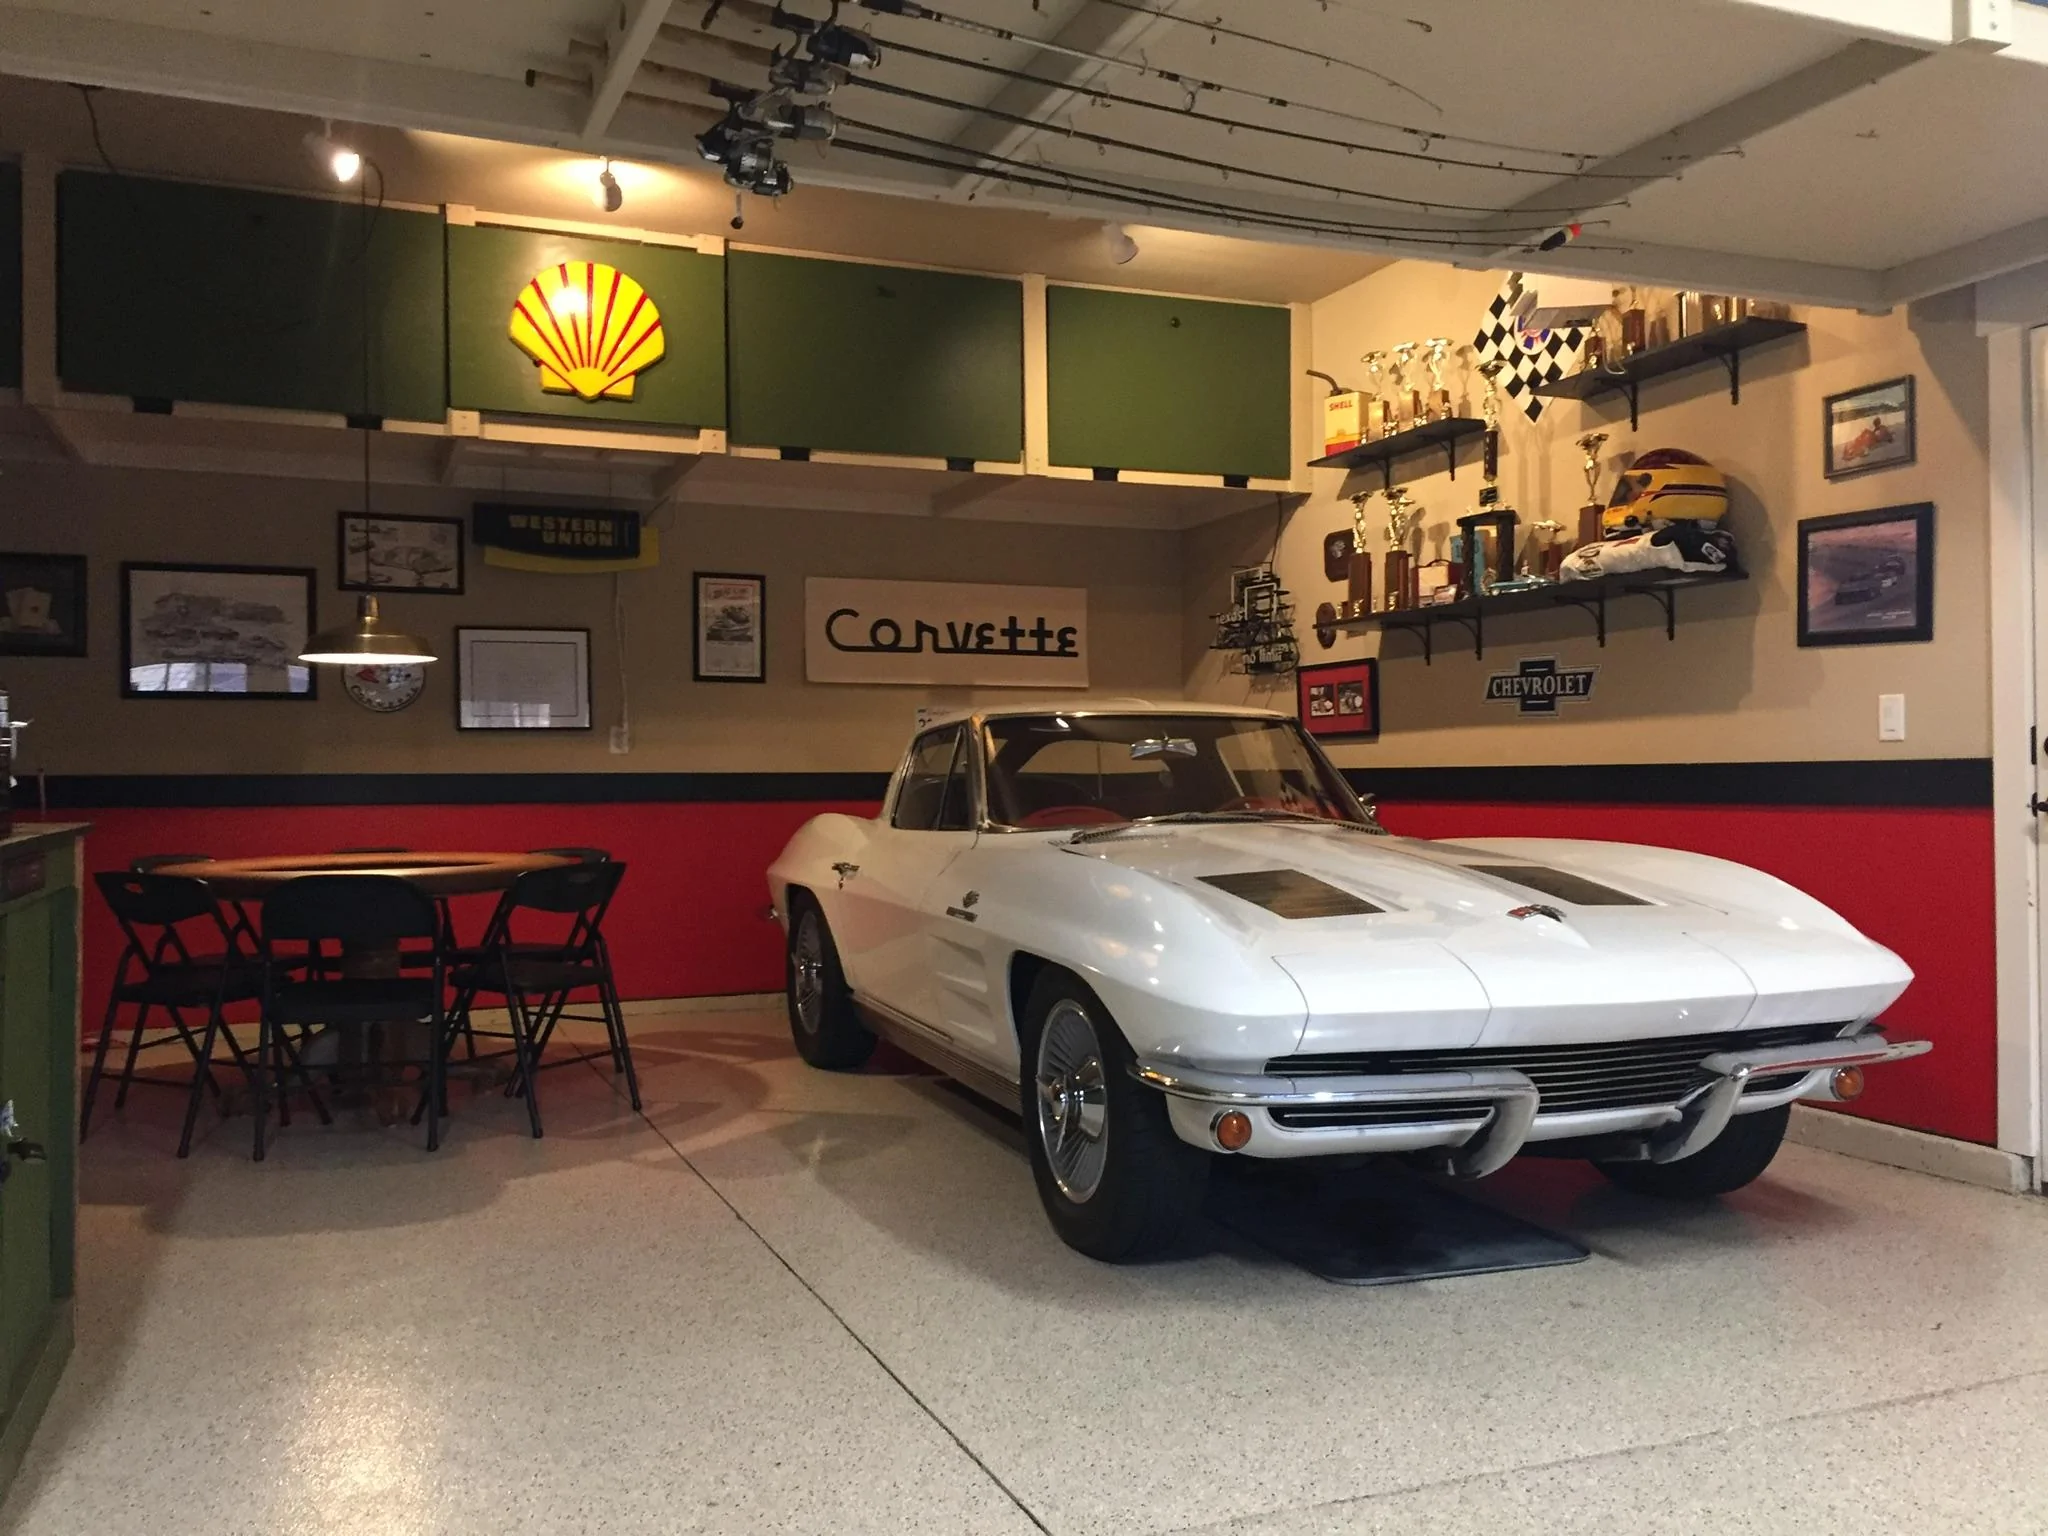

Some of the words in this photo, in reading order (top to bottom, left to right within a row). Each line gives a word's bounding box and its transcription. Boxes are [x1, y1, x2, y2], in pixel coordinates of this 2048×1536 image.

[1329, 400, 1353, 411] SHELL
[509, 514, 613, 533] WESTERN
[542, 531, 613, 547] UNION
[825, 608, 1079, 658] Corvette
[1492, 674, 1587, 697] CHEVROLET
